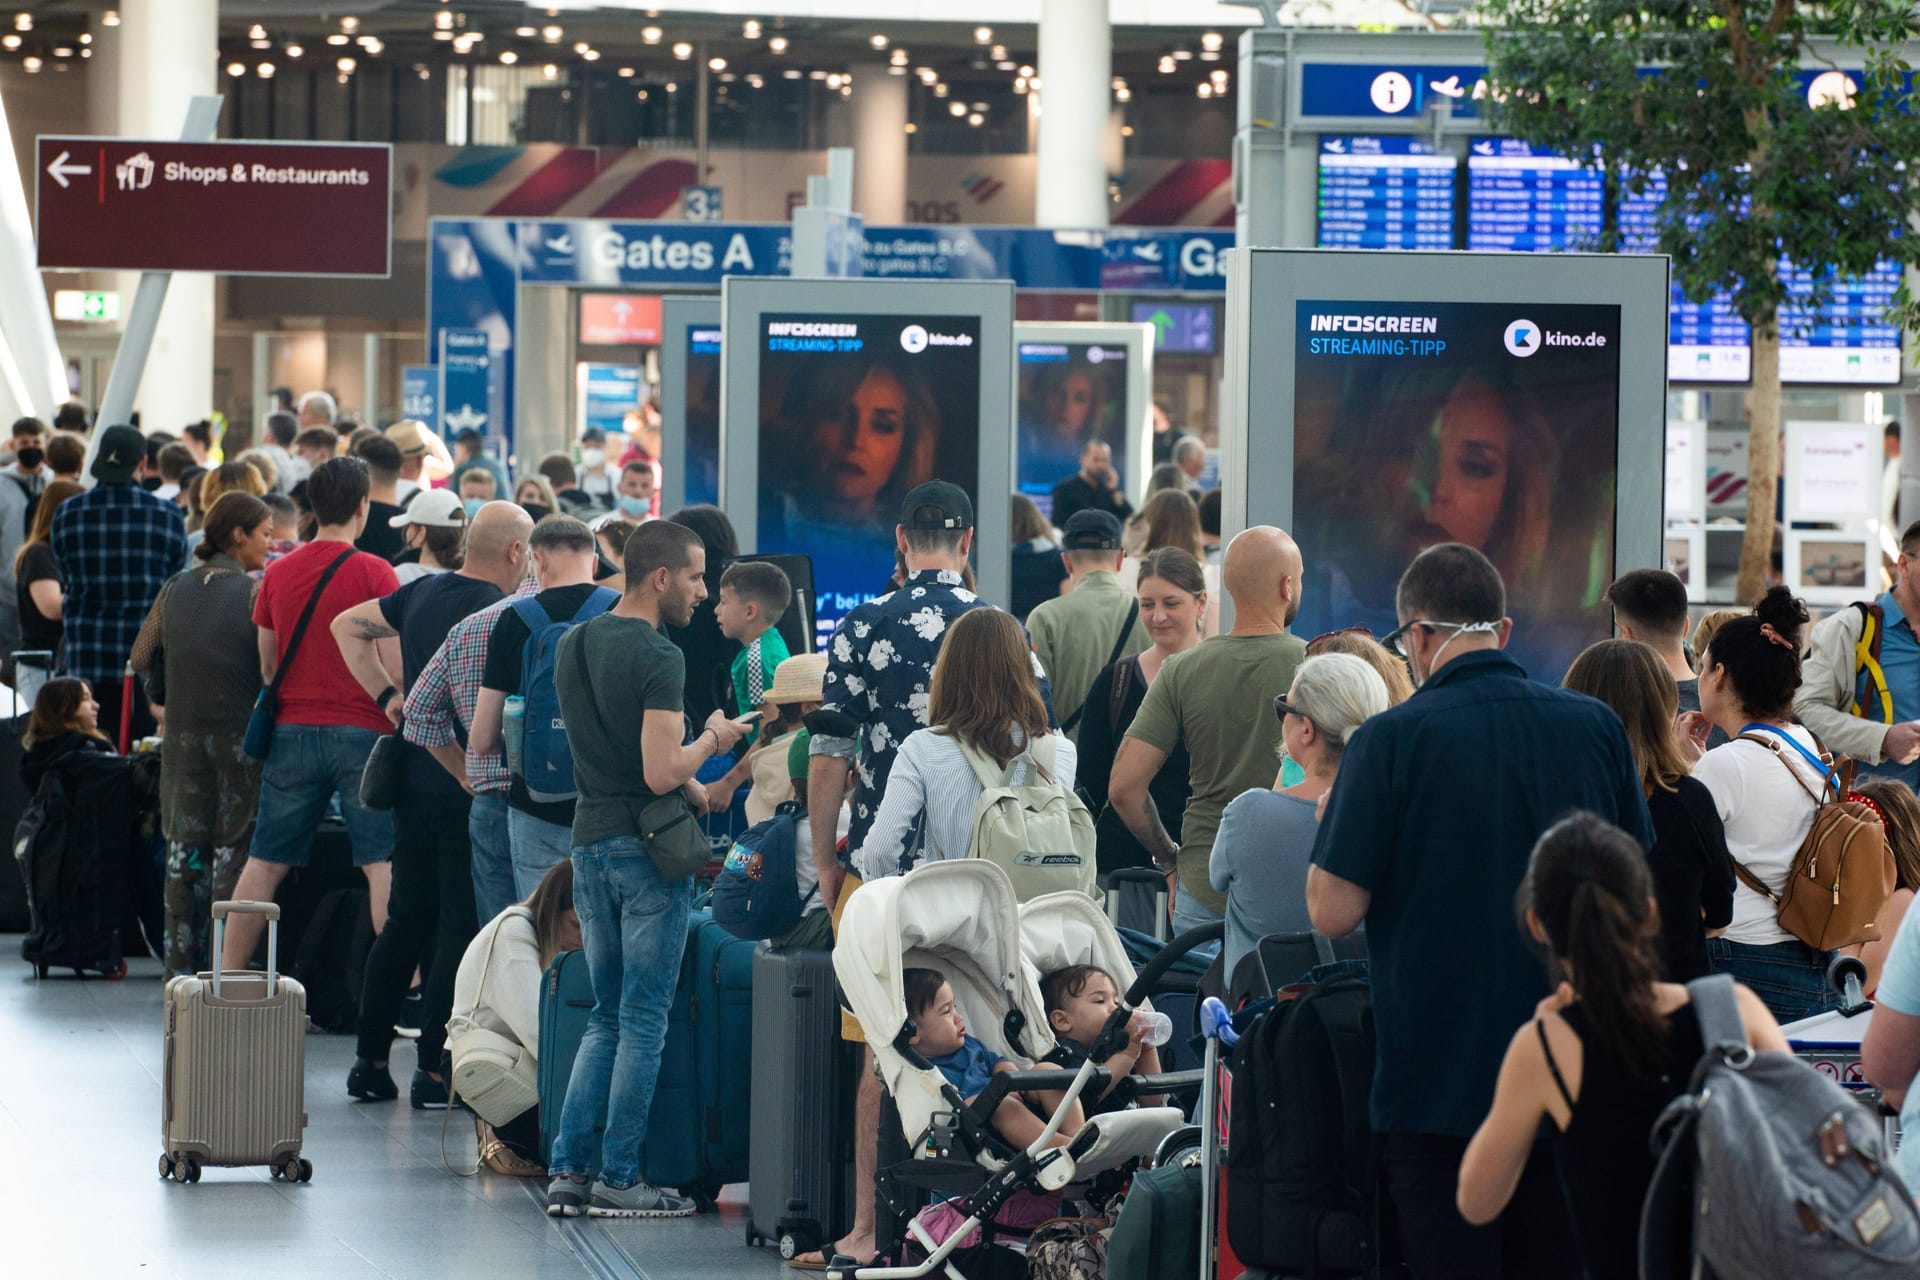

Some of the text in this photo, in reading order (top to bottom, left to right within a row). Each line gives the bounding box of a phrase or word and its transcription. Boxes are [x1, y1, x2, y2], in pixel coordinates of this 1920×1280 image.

[164, 162, 370, 186] Shops & Restaurants
[590, 230, 715, 271] Gates
[721, 233, 755, 271] A
[768, 322, 858, 337] INFOSCREEN
[1310, 315, 1438, 334] INFOSCREEN
[768, 338, 864, 353] STREAMING-TIPP
[929, 333, 974, 347] kino.de
[1310, 338, 1447, 357] STREAMING-TIPP
[1545, 330, 1607, 347] kino.de
